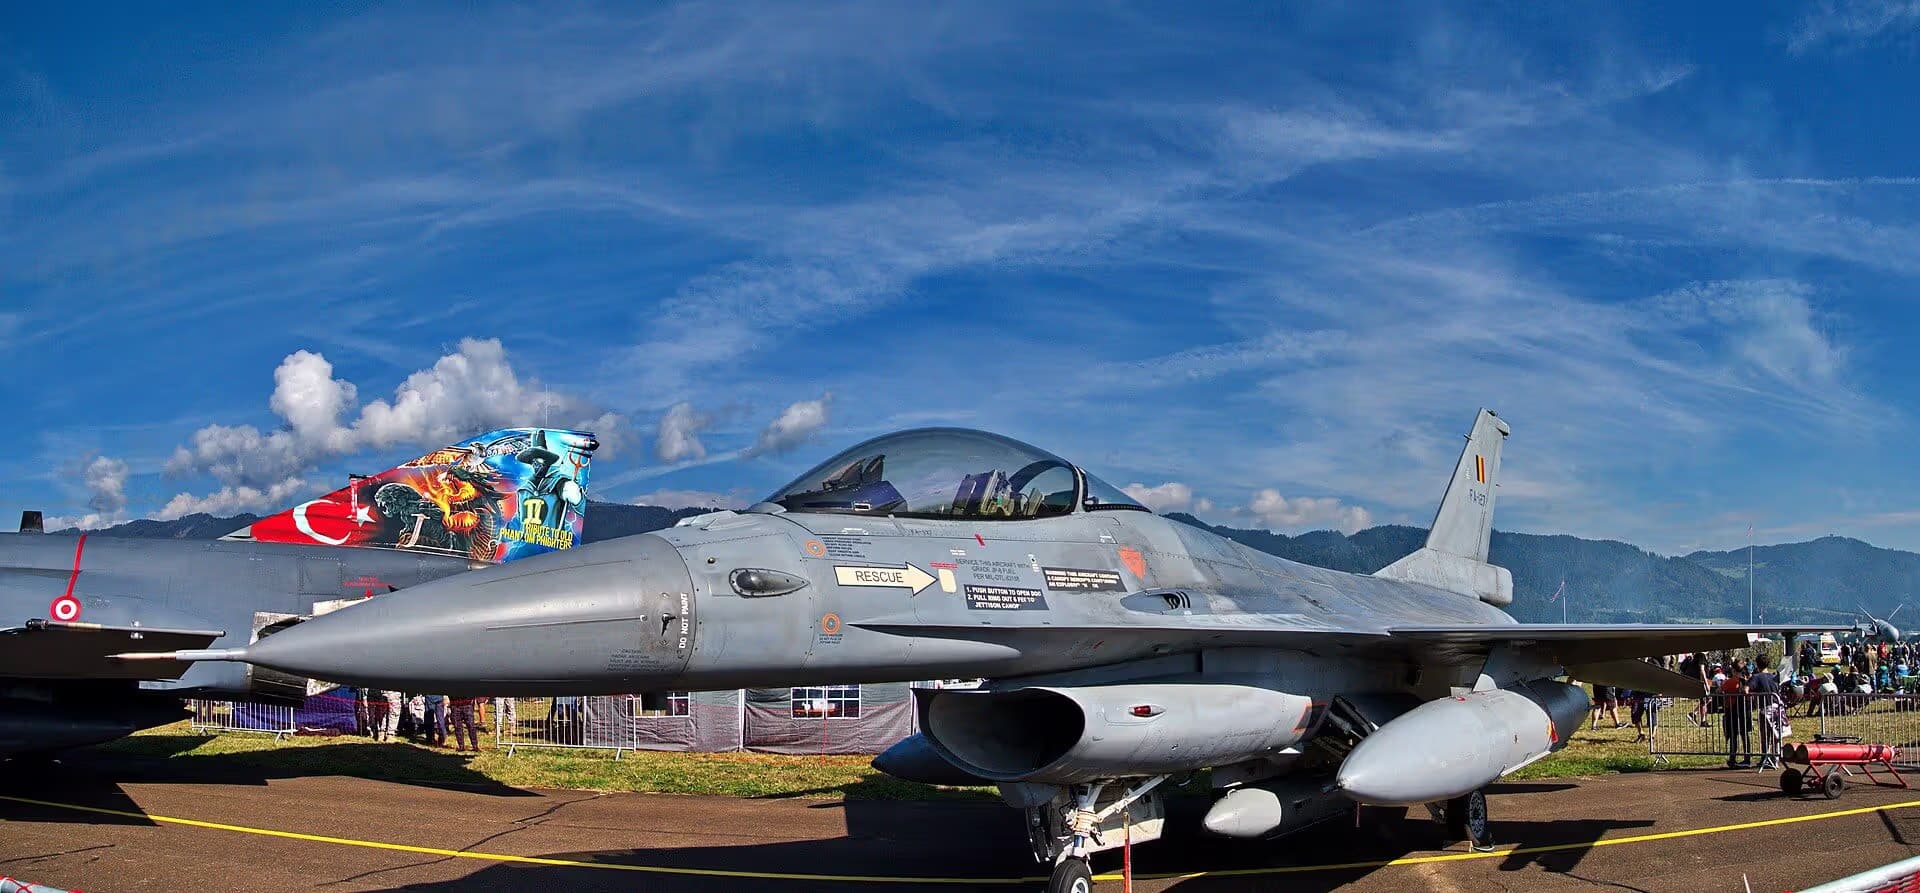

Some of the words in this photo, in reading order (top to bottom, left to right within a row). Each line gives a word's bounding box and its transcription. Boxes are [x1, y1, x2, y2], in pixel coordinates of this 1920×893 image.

[500, 528, 536, 544] PHANTOM
[855, 570, 904, 583] RESCUE
[987, 587, 1009, 595] BUTTON
[680, 592, 689, 615] PAINT
[975, 601, 1001, 609] JETTISON
[681, 617, 689, 634] NOT
[679, 637, 687, 649] DO
